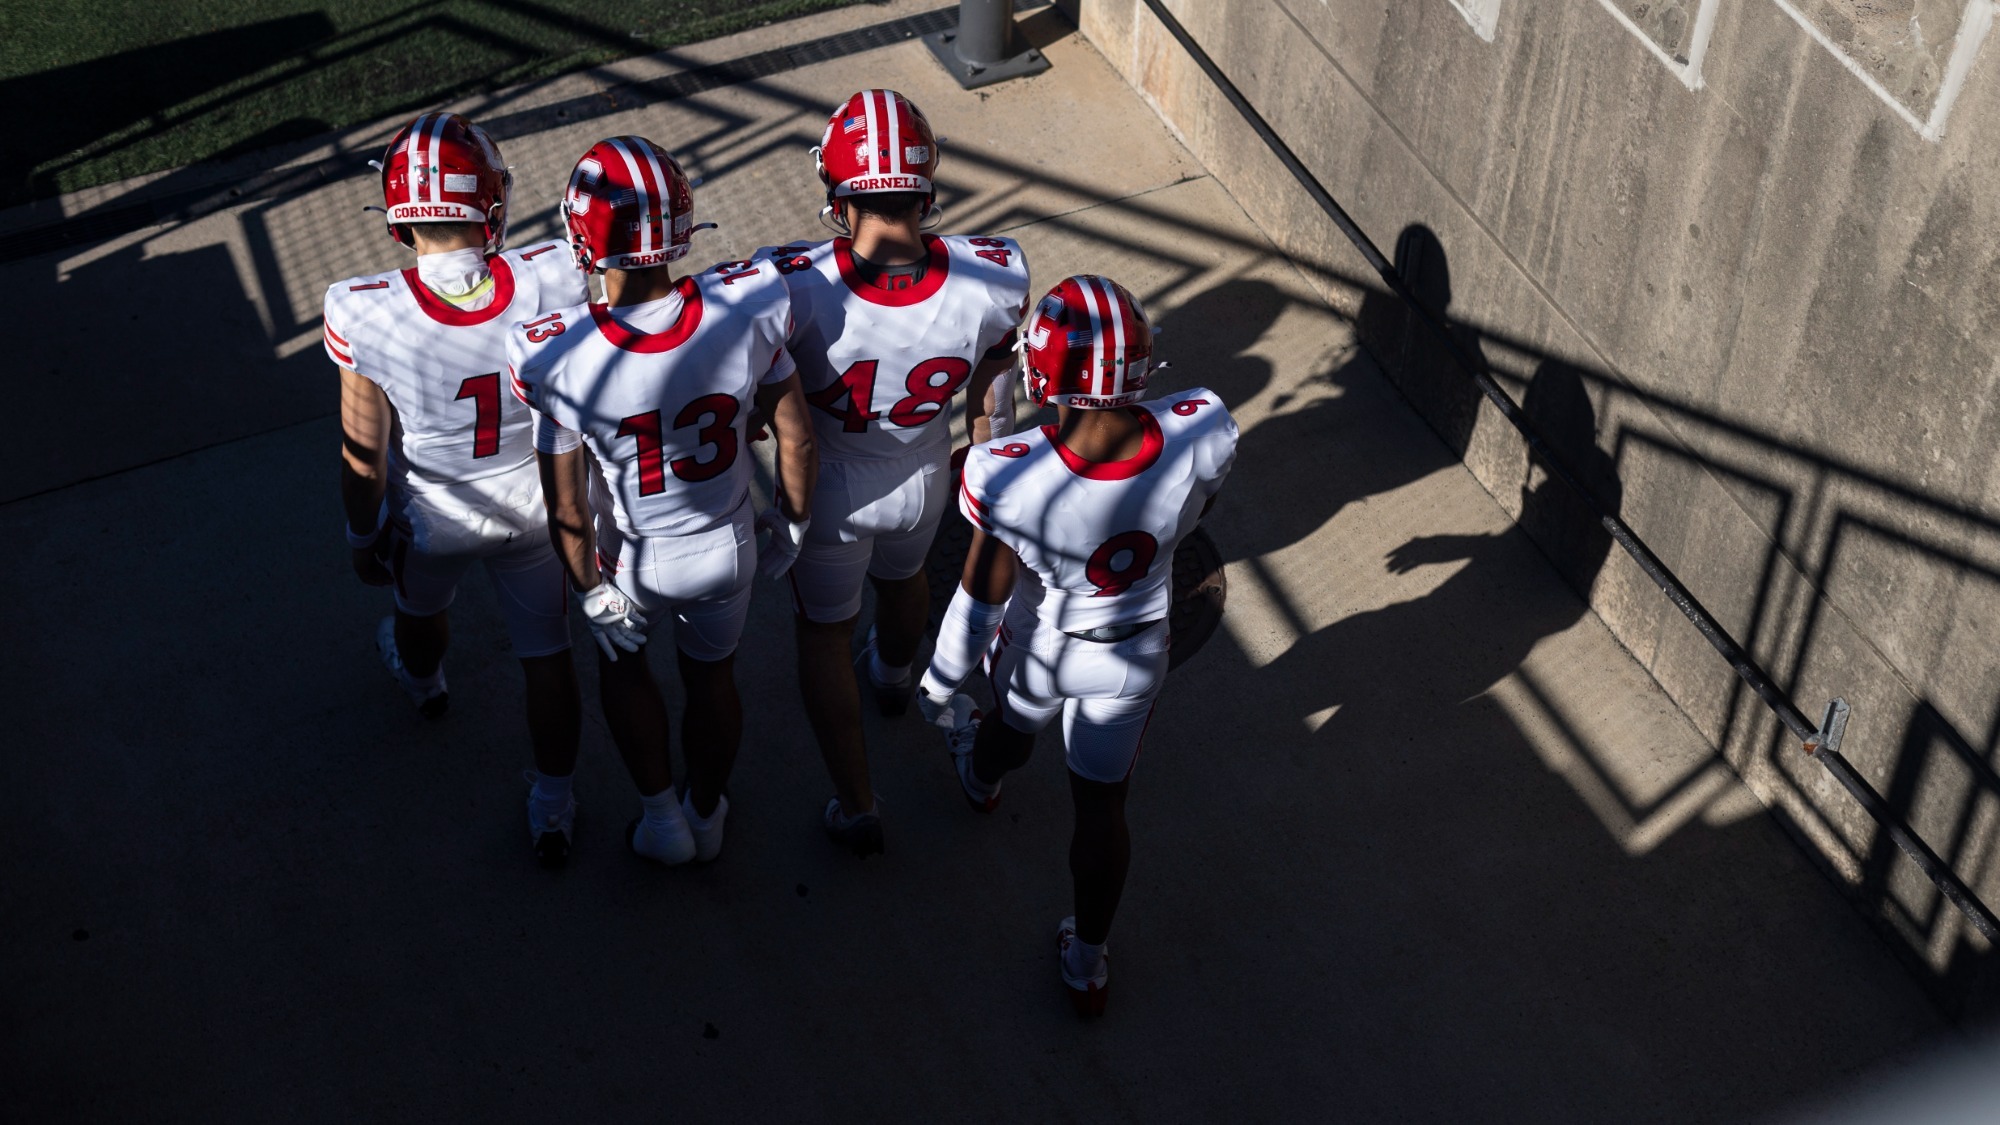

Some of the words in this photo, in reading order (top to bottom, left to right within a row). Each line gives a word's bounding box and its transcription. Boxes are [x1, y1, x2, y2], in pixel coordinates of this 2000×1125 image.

[566, 157, 604, 217] C
[850, 177, 921, 192] CORNELL
[394, 206, 467, 219] CORNELL
[520, 244, 557, 261] 1
[771, 246, 812, 275] 48
[968, 237, 1012, 268] 48
[350, 281, 389, 291] 1
[715, 260, 760, 285] 13
[522, 313, 566, 343] 13
[1028, 293, 1064, 351] C
[1081, 369, 1089, 380] 9
[805, 356, 972, 434] 48
[1068, 393, 1136, 408] CORNEL
[1171, 399, 1210, 416] 9
[454, 372, 501, 459] 1
[614, 392, 740, 498] 13
[989, 442, 1031, 458] 9
[1085, 530, 1158, 597] 9
